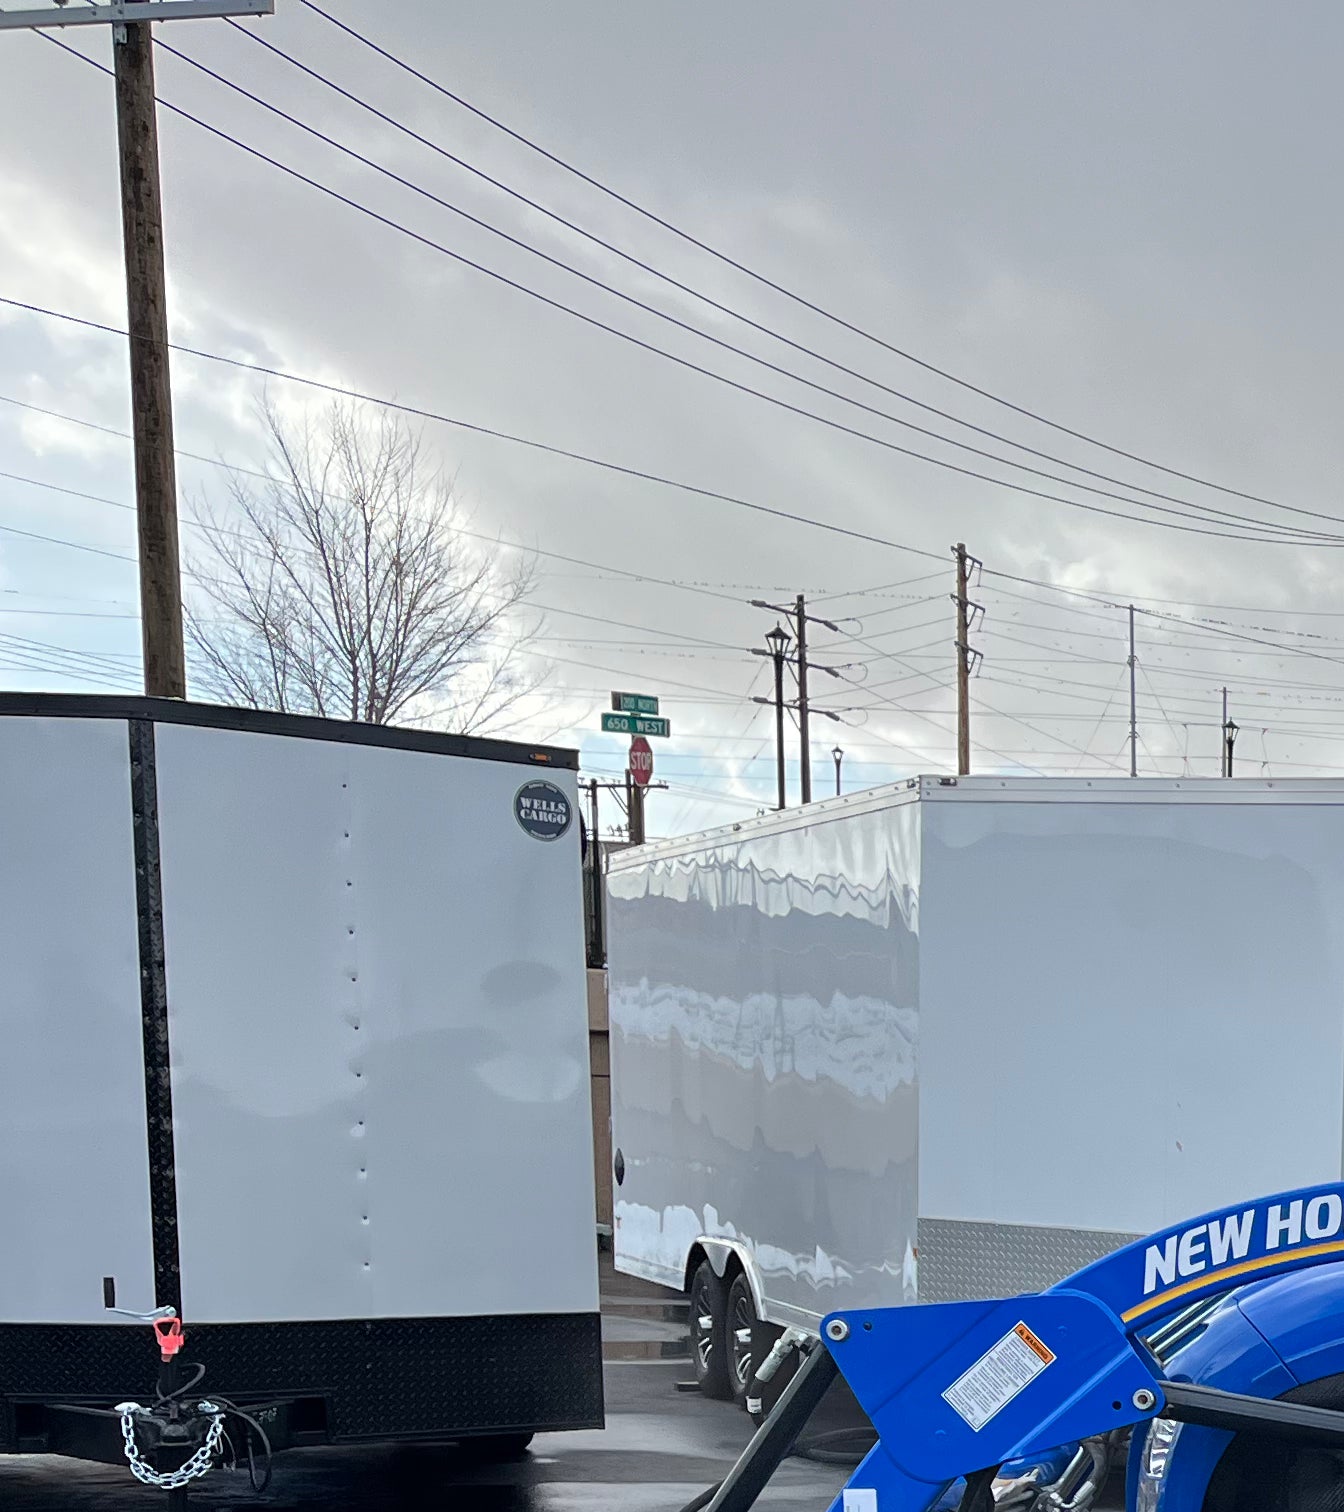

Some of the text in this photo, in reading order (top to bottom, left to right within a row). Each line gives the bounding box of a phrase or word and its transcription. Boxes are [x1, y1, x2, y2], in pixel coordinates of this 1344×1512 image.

[607, 718, 664, 733] 650 WEST
[630, 751, 652, 771] STOP
[520, 796, 566, 813] WELLS
[520, 808, 566, 824] CARGO
[1143, 1209, 1255, 1295] NEW
